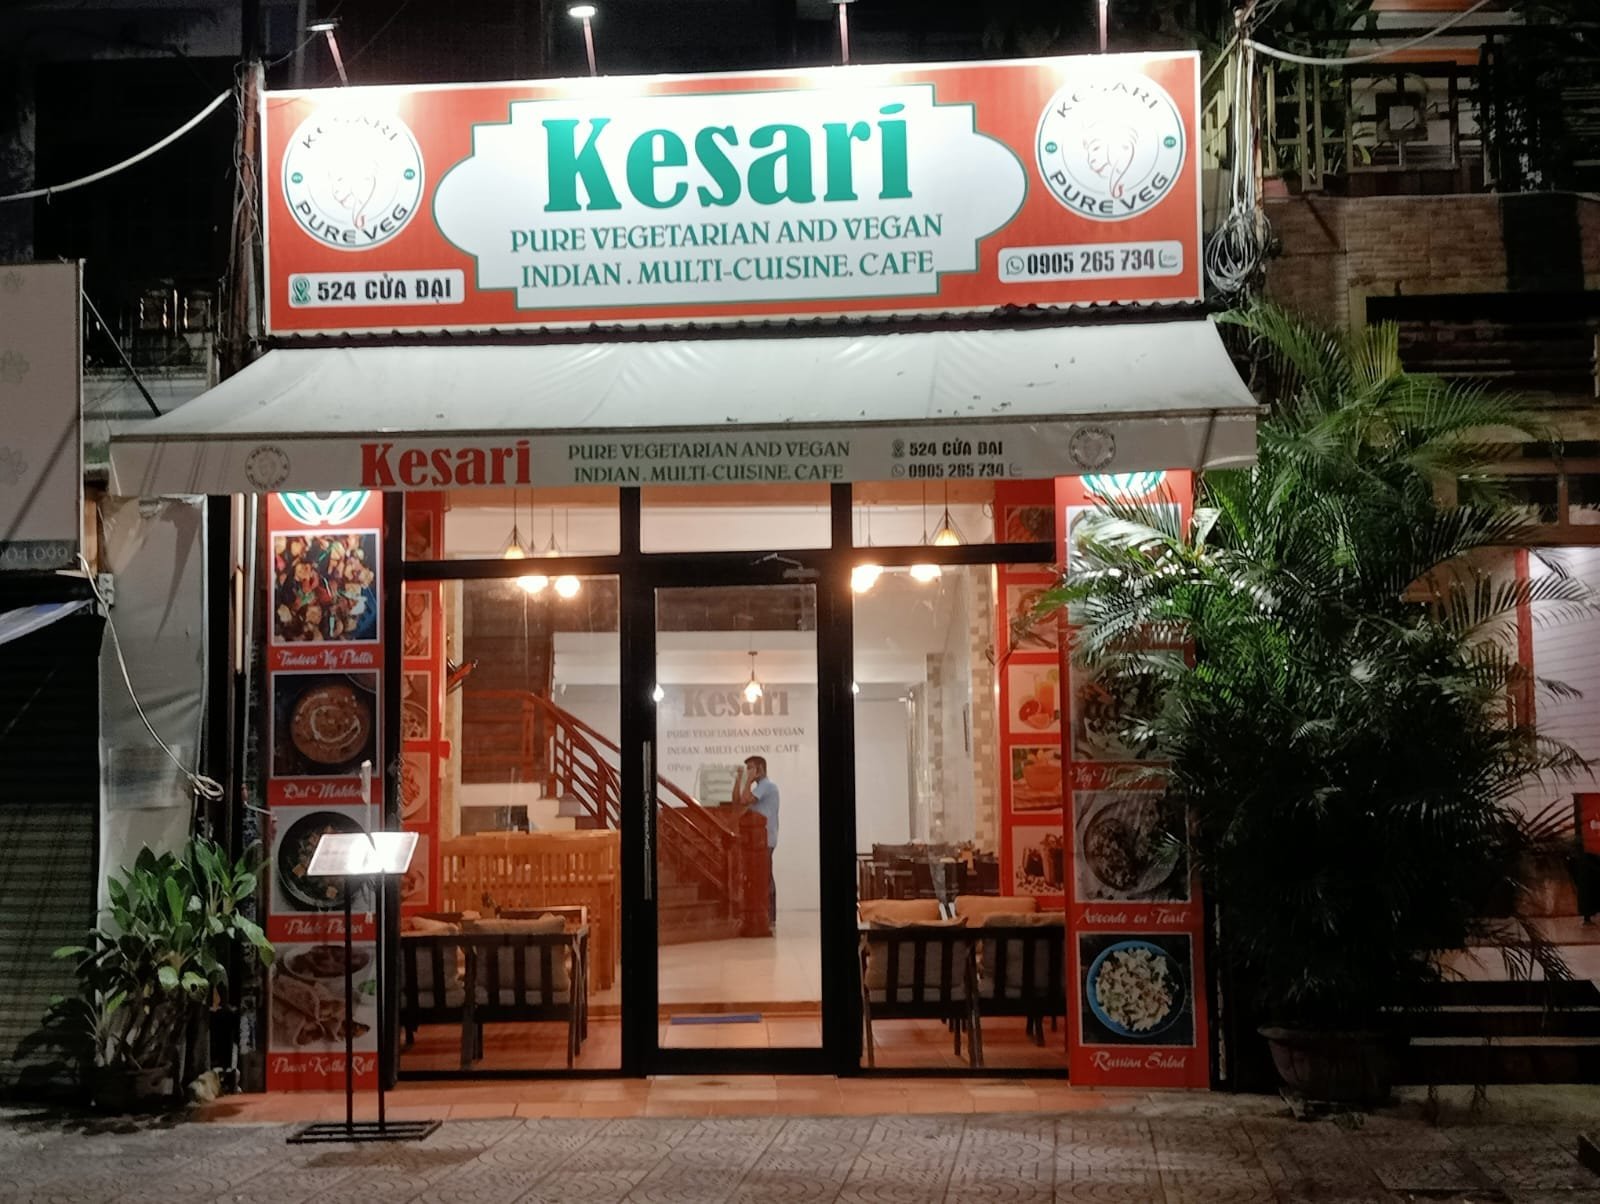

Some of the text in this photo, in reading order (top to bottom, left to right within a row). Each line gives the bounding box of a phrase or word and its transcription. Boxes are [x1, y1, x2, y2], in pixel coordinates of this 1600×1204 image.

[542, 103, 913, 213] Kesari
[1050, 169, 1169, 214] PURE VEG
[296, 200, 408, 245] PURE VEG
[510, 213, 943, 254] PURE VEGETARIAN AND VEGAN
[859, 251, 935, 277] CAFE
[1027, 252, 1074, 276] 0905
[1080, 250, 1115, 274] 265
[1120, 248, 1155, 271] 734
[317, 280, 357, 302] 524
[364, 272, 408, 301] CỬA
[568, 440, 850, 461] PURE VEGETARIAN AND VEGAN
[909, 442, 937, 457] 524
[360, 440, 532, 488] Kesari
[794, 463, 843, 480] CAFE
[908, 463, 944, 478] 0905
[949, 463, 975, 478] 265
[979, 462, 1004, 477] 734
[751, 728, 772, 738] AND
[283, 782, 310, 800] Dal
[1089, 1050, 1187, 1072] Russian Salad
